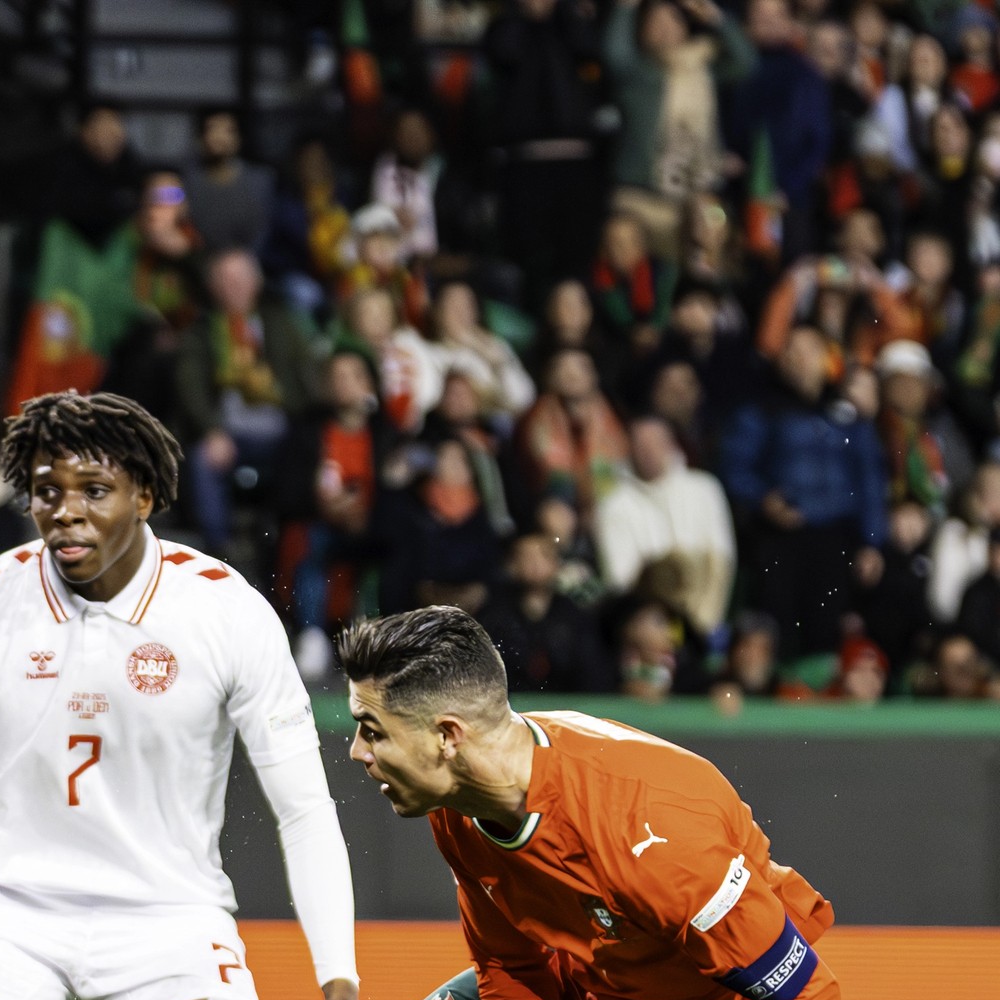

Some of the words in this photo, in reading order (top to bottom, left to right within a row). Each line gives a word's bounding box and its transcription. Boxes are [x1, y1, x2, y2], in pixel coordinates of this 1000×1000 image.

[137, 659, 169, 677] DBU
[68, 734, 103, 806] 7
[765, 938, 804, 989] RESPECT
